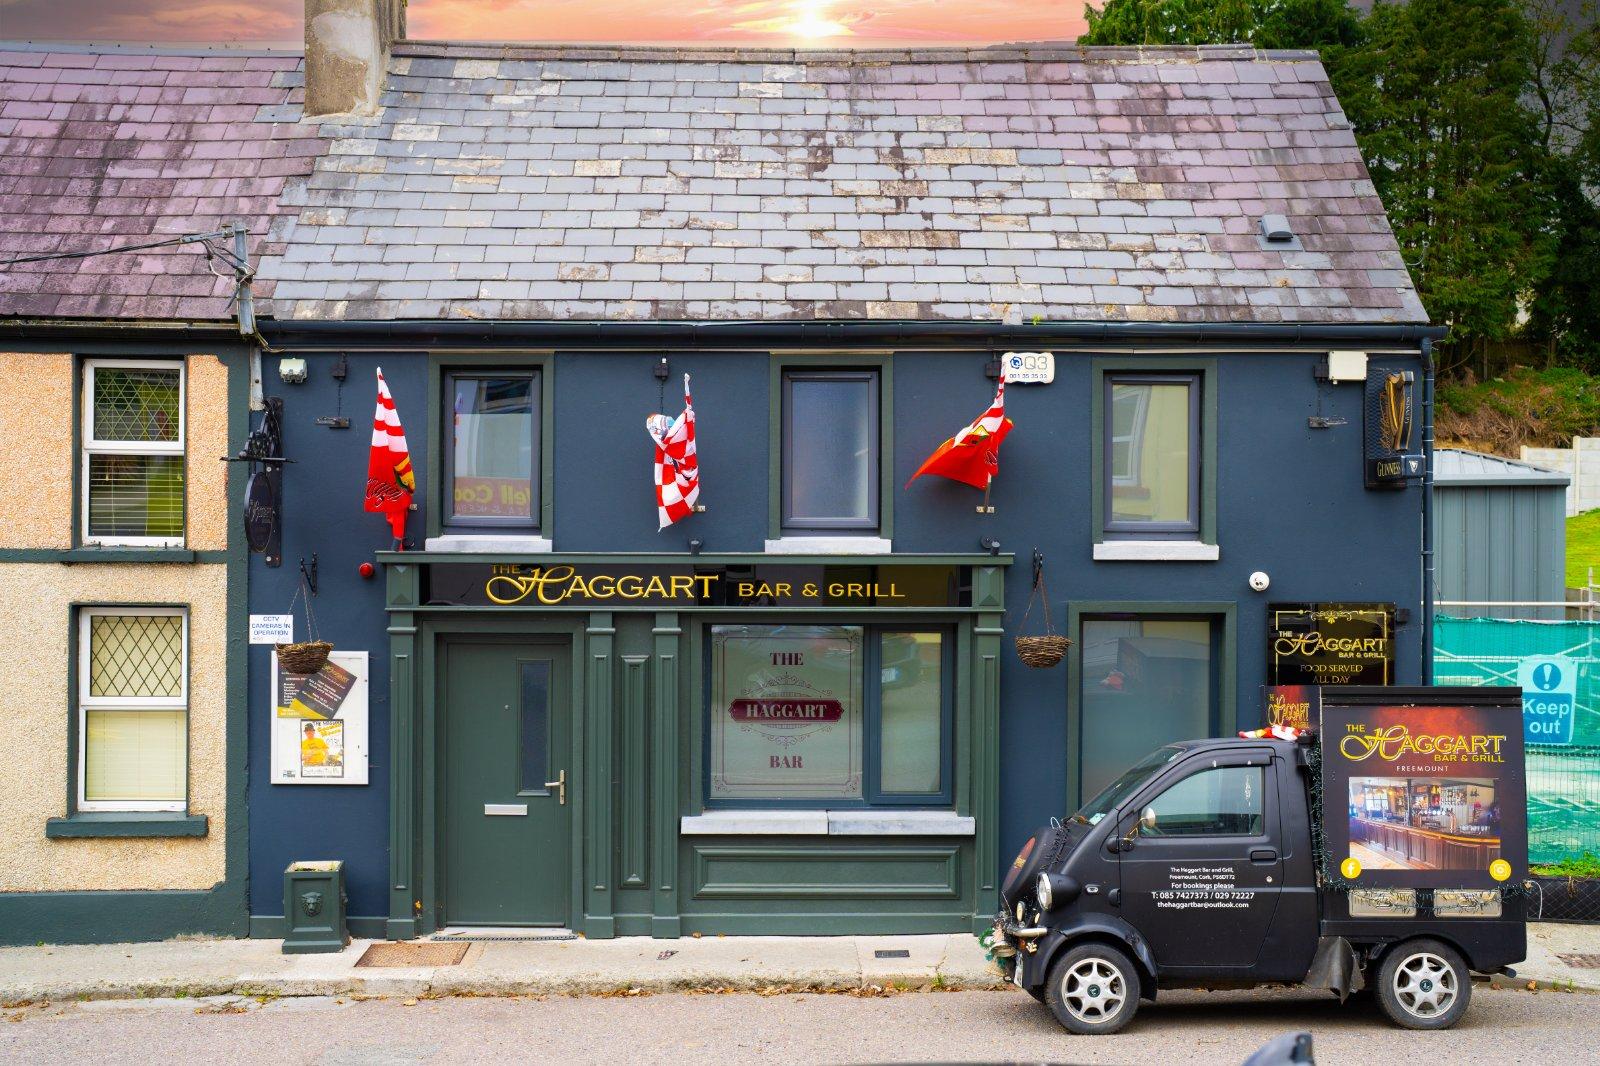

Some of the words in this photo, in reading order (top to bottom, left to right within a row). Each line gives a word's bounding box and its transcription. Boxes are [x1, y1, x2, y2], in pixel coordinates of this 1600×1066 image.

[1377, 462, 1400, 476] GUINNESS
[491, 564, 520, 574] THE
[486, 566, 718, 604] HAGGART
[738, 583, 792, 597] BAR
[802, 583, 818, 597] &
[828, 583, 906, 597] GRILL
[1274, 632, 1387, 656] HAGGART
[770, 653, 804, 666] THE
[1312, 676, 1330, 684] ALL
[1332, 676, 1350, 684] DAY
[746, 704, 826, 718] HAGGART
[1523, 698, 1570, 718] Keep
[1346, 724, 1365, 732] THE
[1530, 719, 1560, 734] out
[1340, 725, 1506, 762] HAGGART
[770, 756, 804, 768] BAR
[1472, 754, 1504, 762] GRILL
